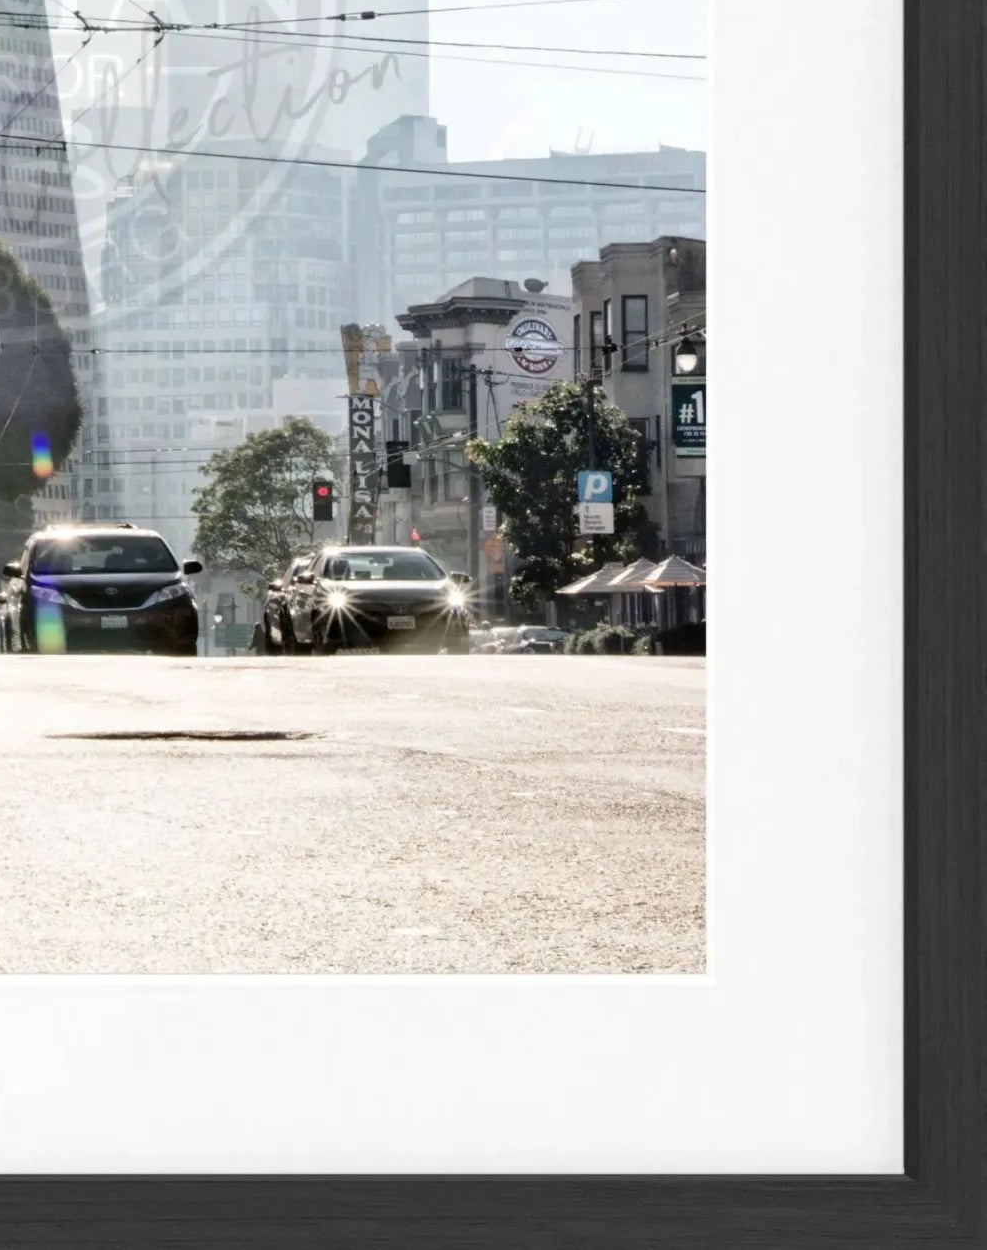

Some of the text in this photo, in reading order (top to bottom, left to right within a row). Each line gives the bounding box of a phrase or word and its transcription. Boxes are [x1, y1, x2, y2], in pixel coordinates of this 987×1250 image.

[349, 396, 373, 455] MONA
[678, 389, 705, 424] #1
[353, 460, 374, 519] LISA
